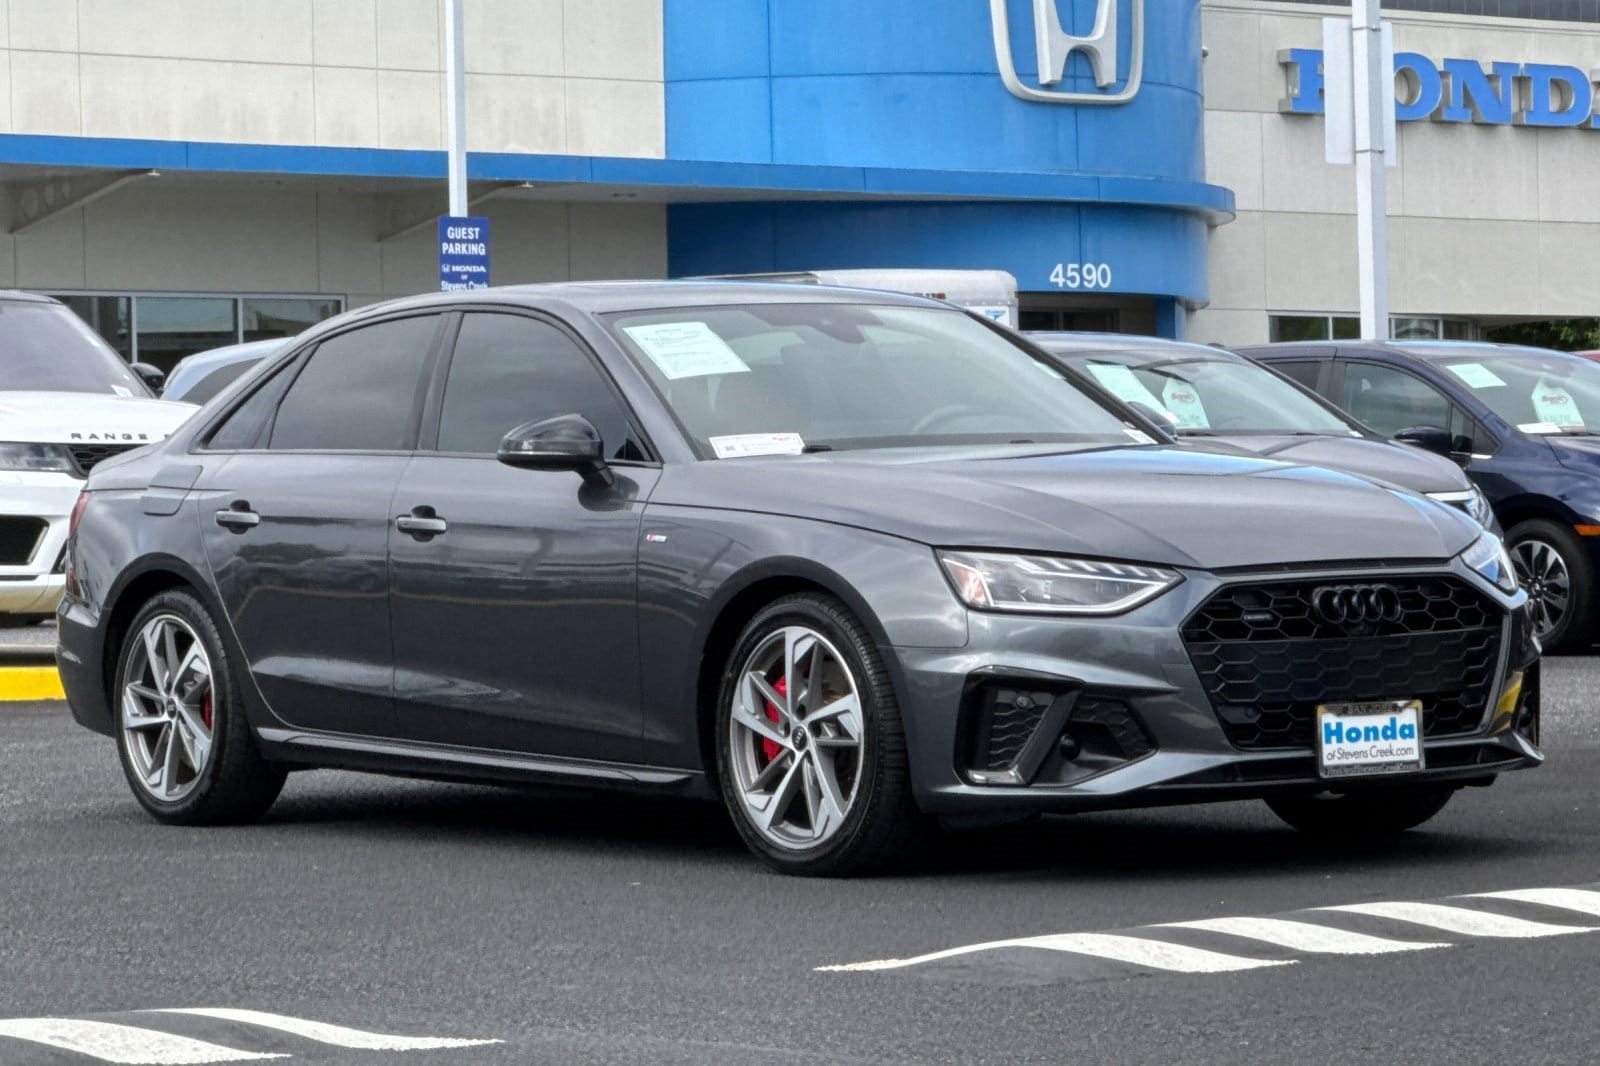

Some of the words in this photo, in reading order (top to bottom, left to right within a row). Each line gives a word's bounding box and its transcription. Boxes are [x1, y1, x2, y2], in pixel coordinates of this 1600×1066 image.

[1279, 47, 1600, 129] OND
[447, 226, 480, 240] GUEST
[442, 242, 486, 256] PARKING
[452, 265, 487, 273] HONDA
[1050, 263, 1112, 289] 4590
[71, 432, 148, 441] RANGE
[1324, 716, 1415, 745] Honda
[1326, 751, 1336, 761] of
[1337, 747, 1369, 761] Stevens
[1369, 744, 1414, 759] Creek.com
